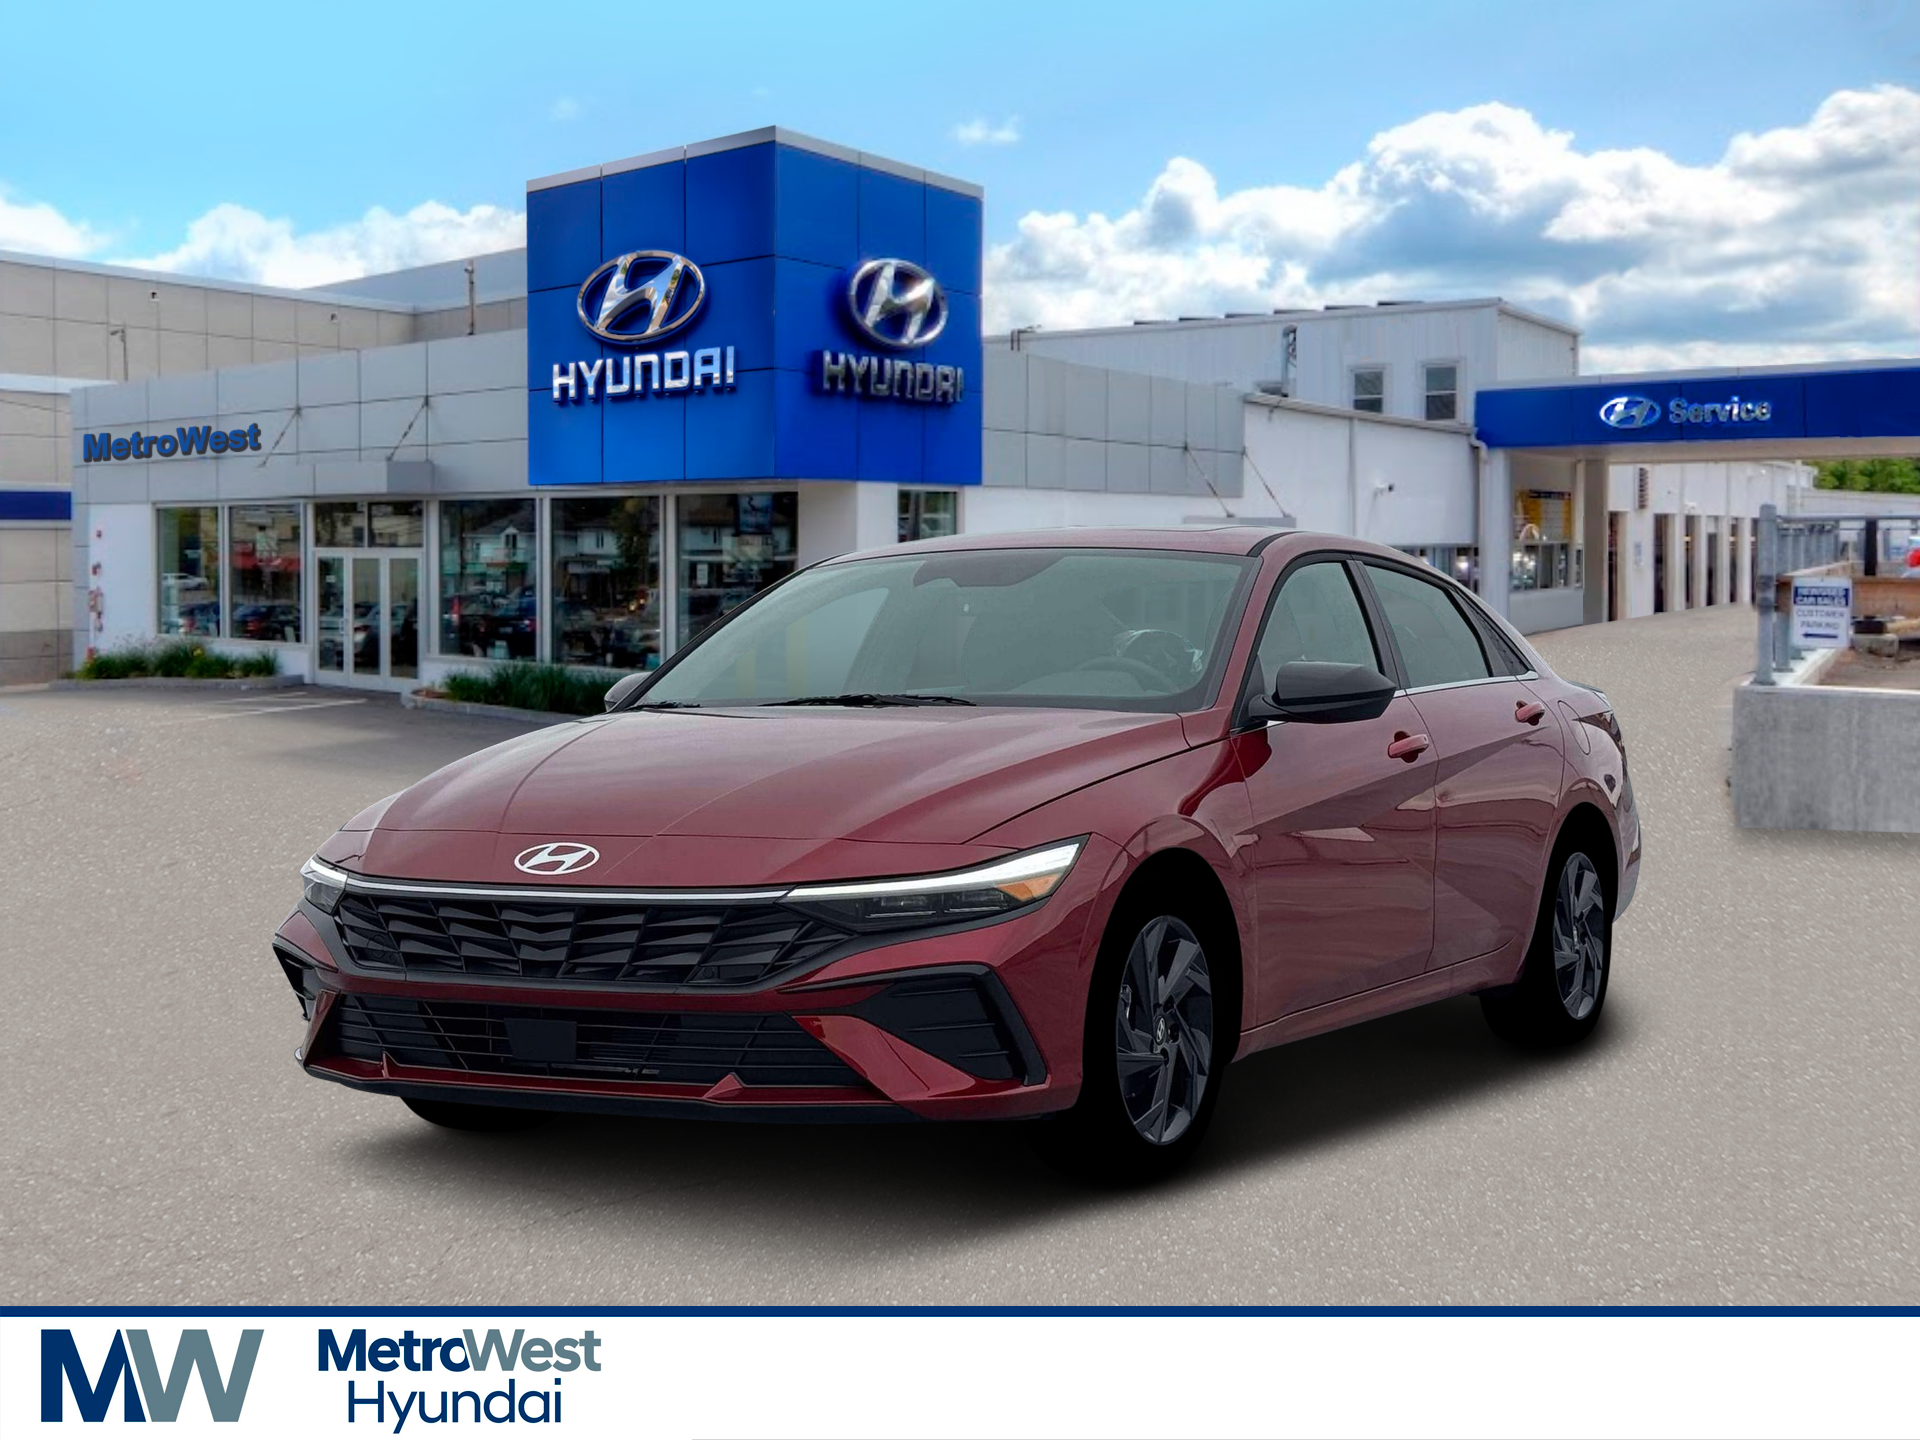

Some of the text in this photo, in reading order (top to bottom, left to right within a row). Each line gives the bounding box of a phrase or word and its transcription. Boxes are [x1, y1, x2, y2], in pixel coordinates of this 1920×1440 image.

[551, 345, 737, 405] HYUNDAI
[821, 349, 965, 404] HYUNDAI
[1667, 395, 1773, 424] Service
[82, 422, 262, 463] MetroWest
[1796, 609, 1844, 618] CUSTOMER
[1800, 620, 1840, 630] PARKING
